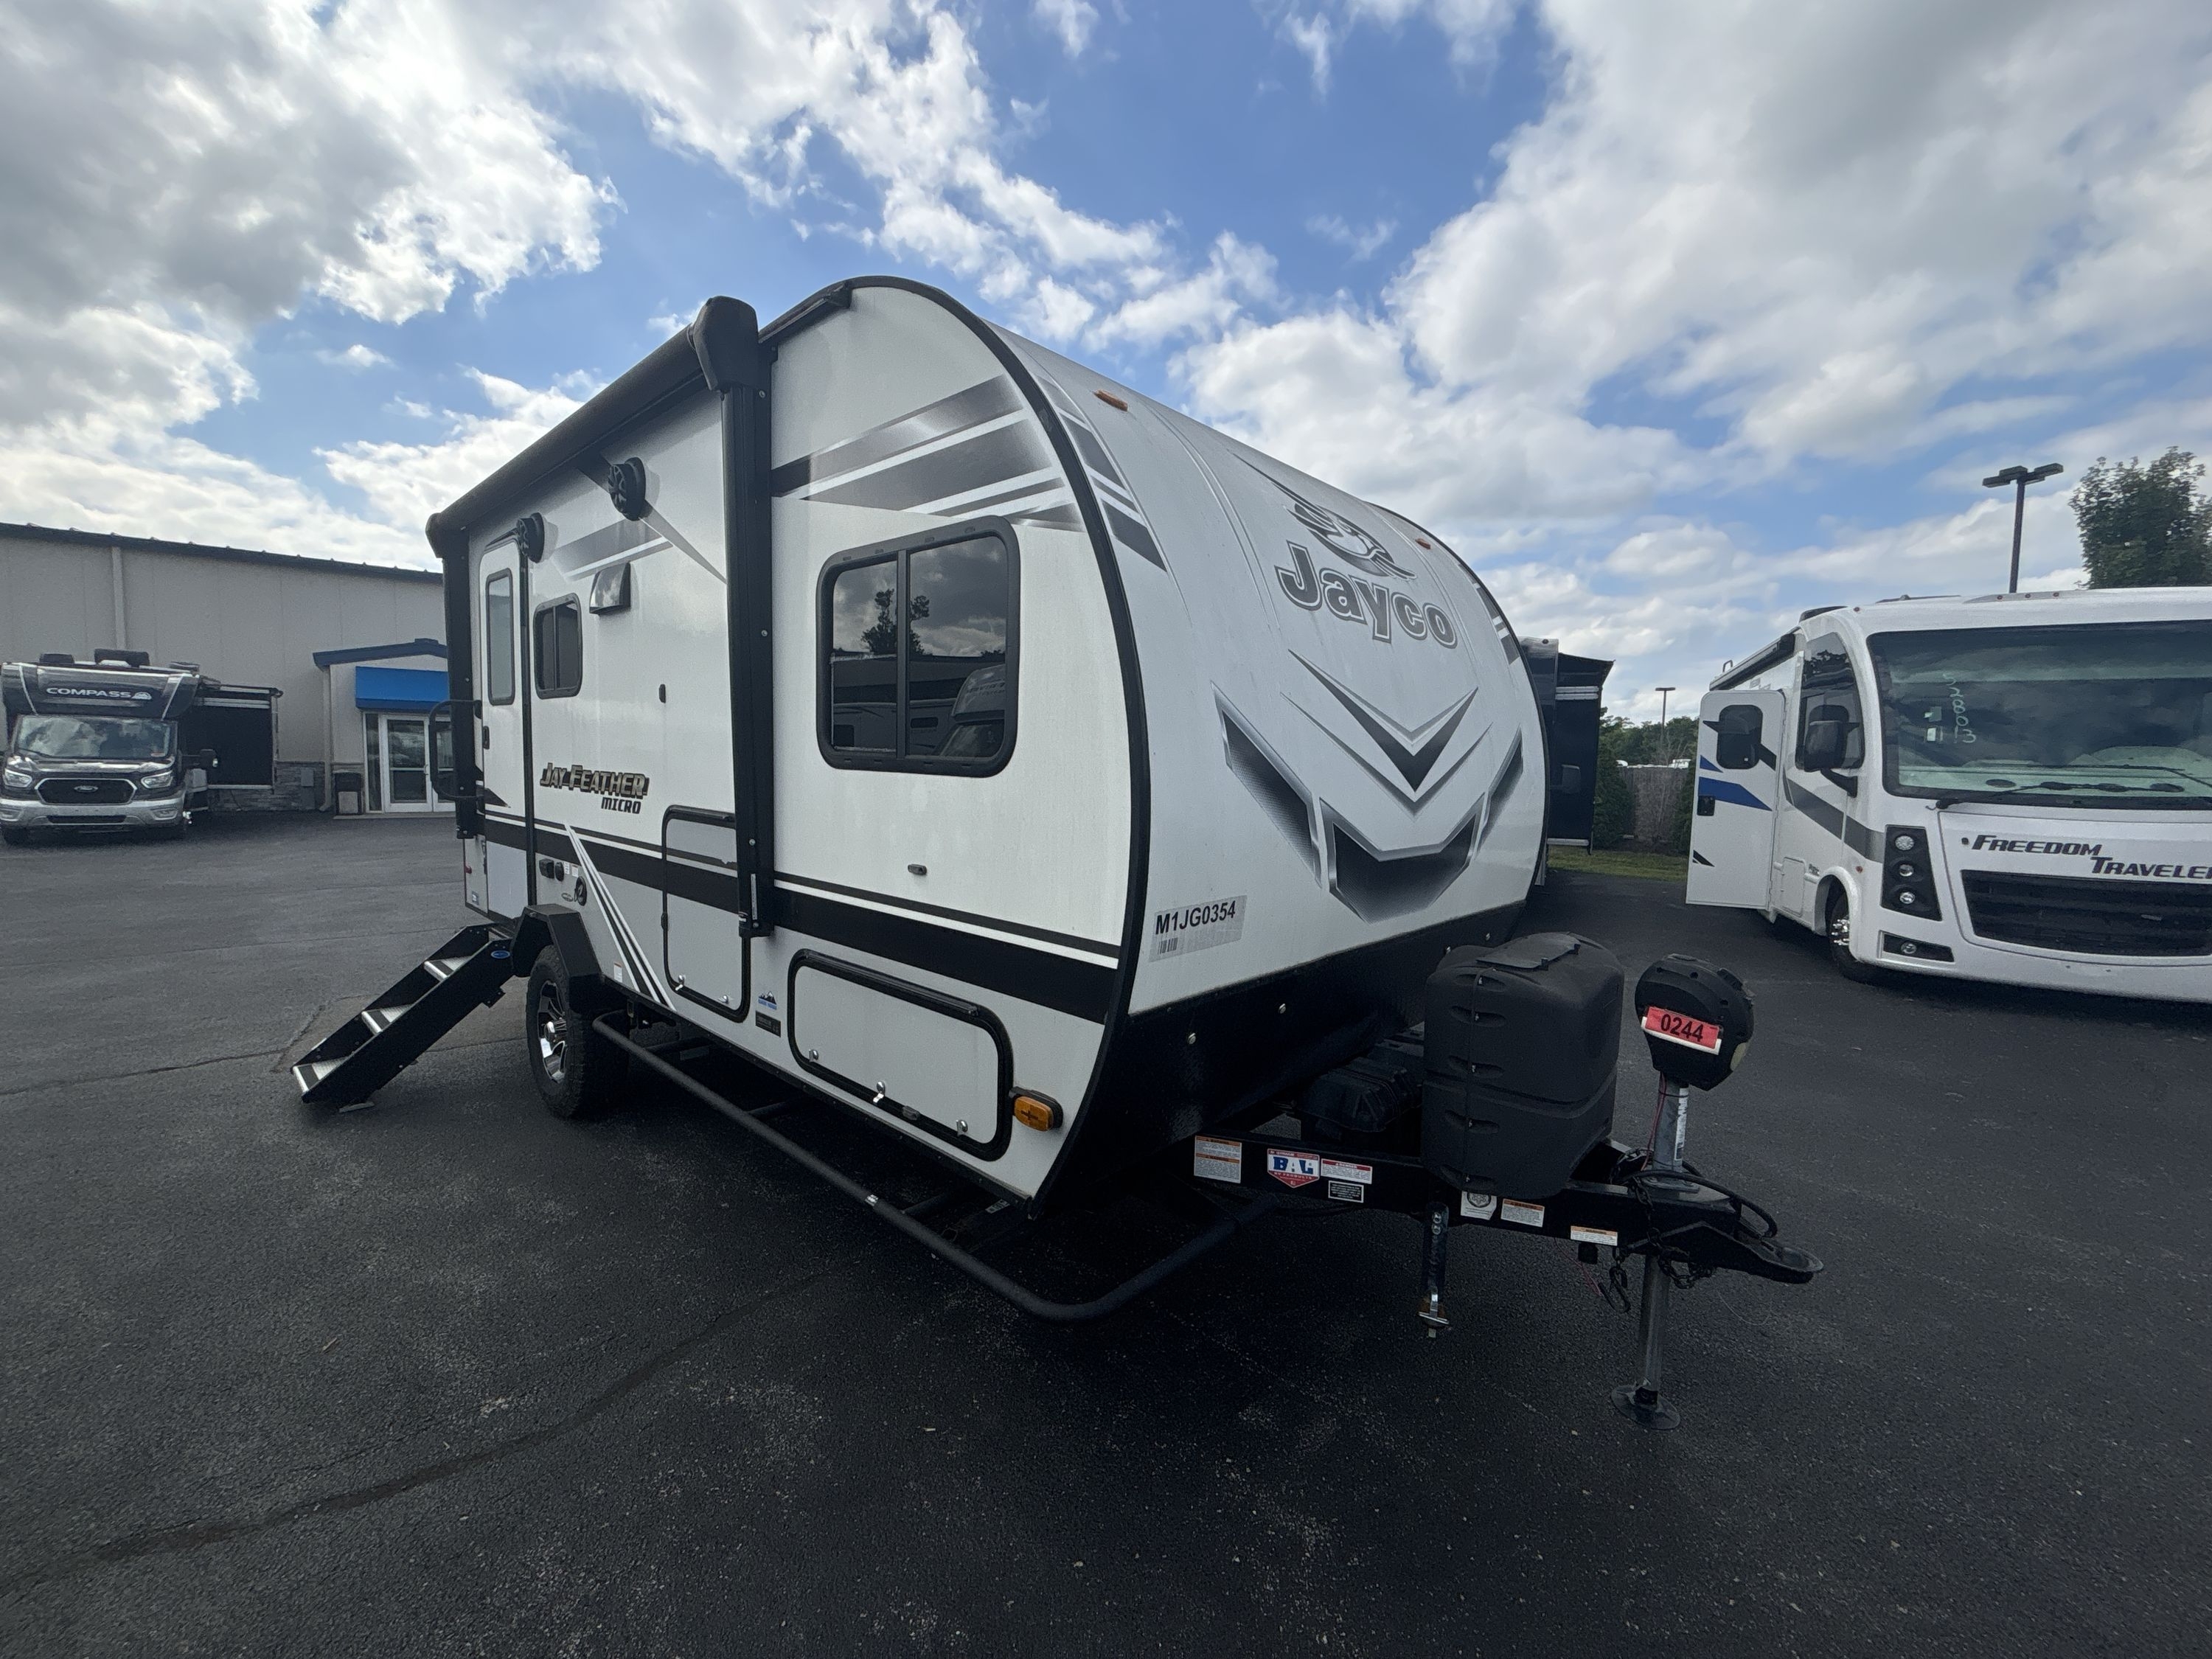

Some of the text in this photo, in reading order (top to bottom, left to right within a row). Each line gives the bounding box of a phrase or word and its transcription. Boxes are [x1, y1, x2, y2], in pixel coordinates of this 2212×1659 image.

[1274, 540, 1458, 649] Jayco
[46, 687, 132, 698] COMPASS
[568, 764, 650, 799] FEATHER
[601, 797, 641, 814] MICRO
[1972, 835, 2102, 856] FREEDOM
[1155, 900, 1236, 935] M1JG0354
[1660, 1014, 1703, 1042] 0244
[1273, 1156, 1313, 1175] BAL
